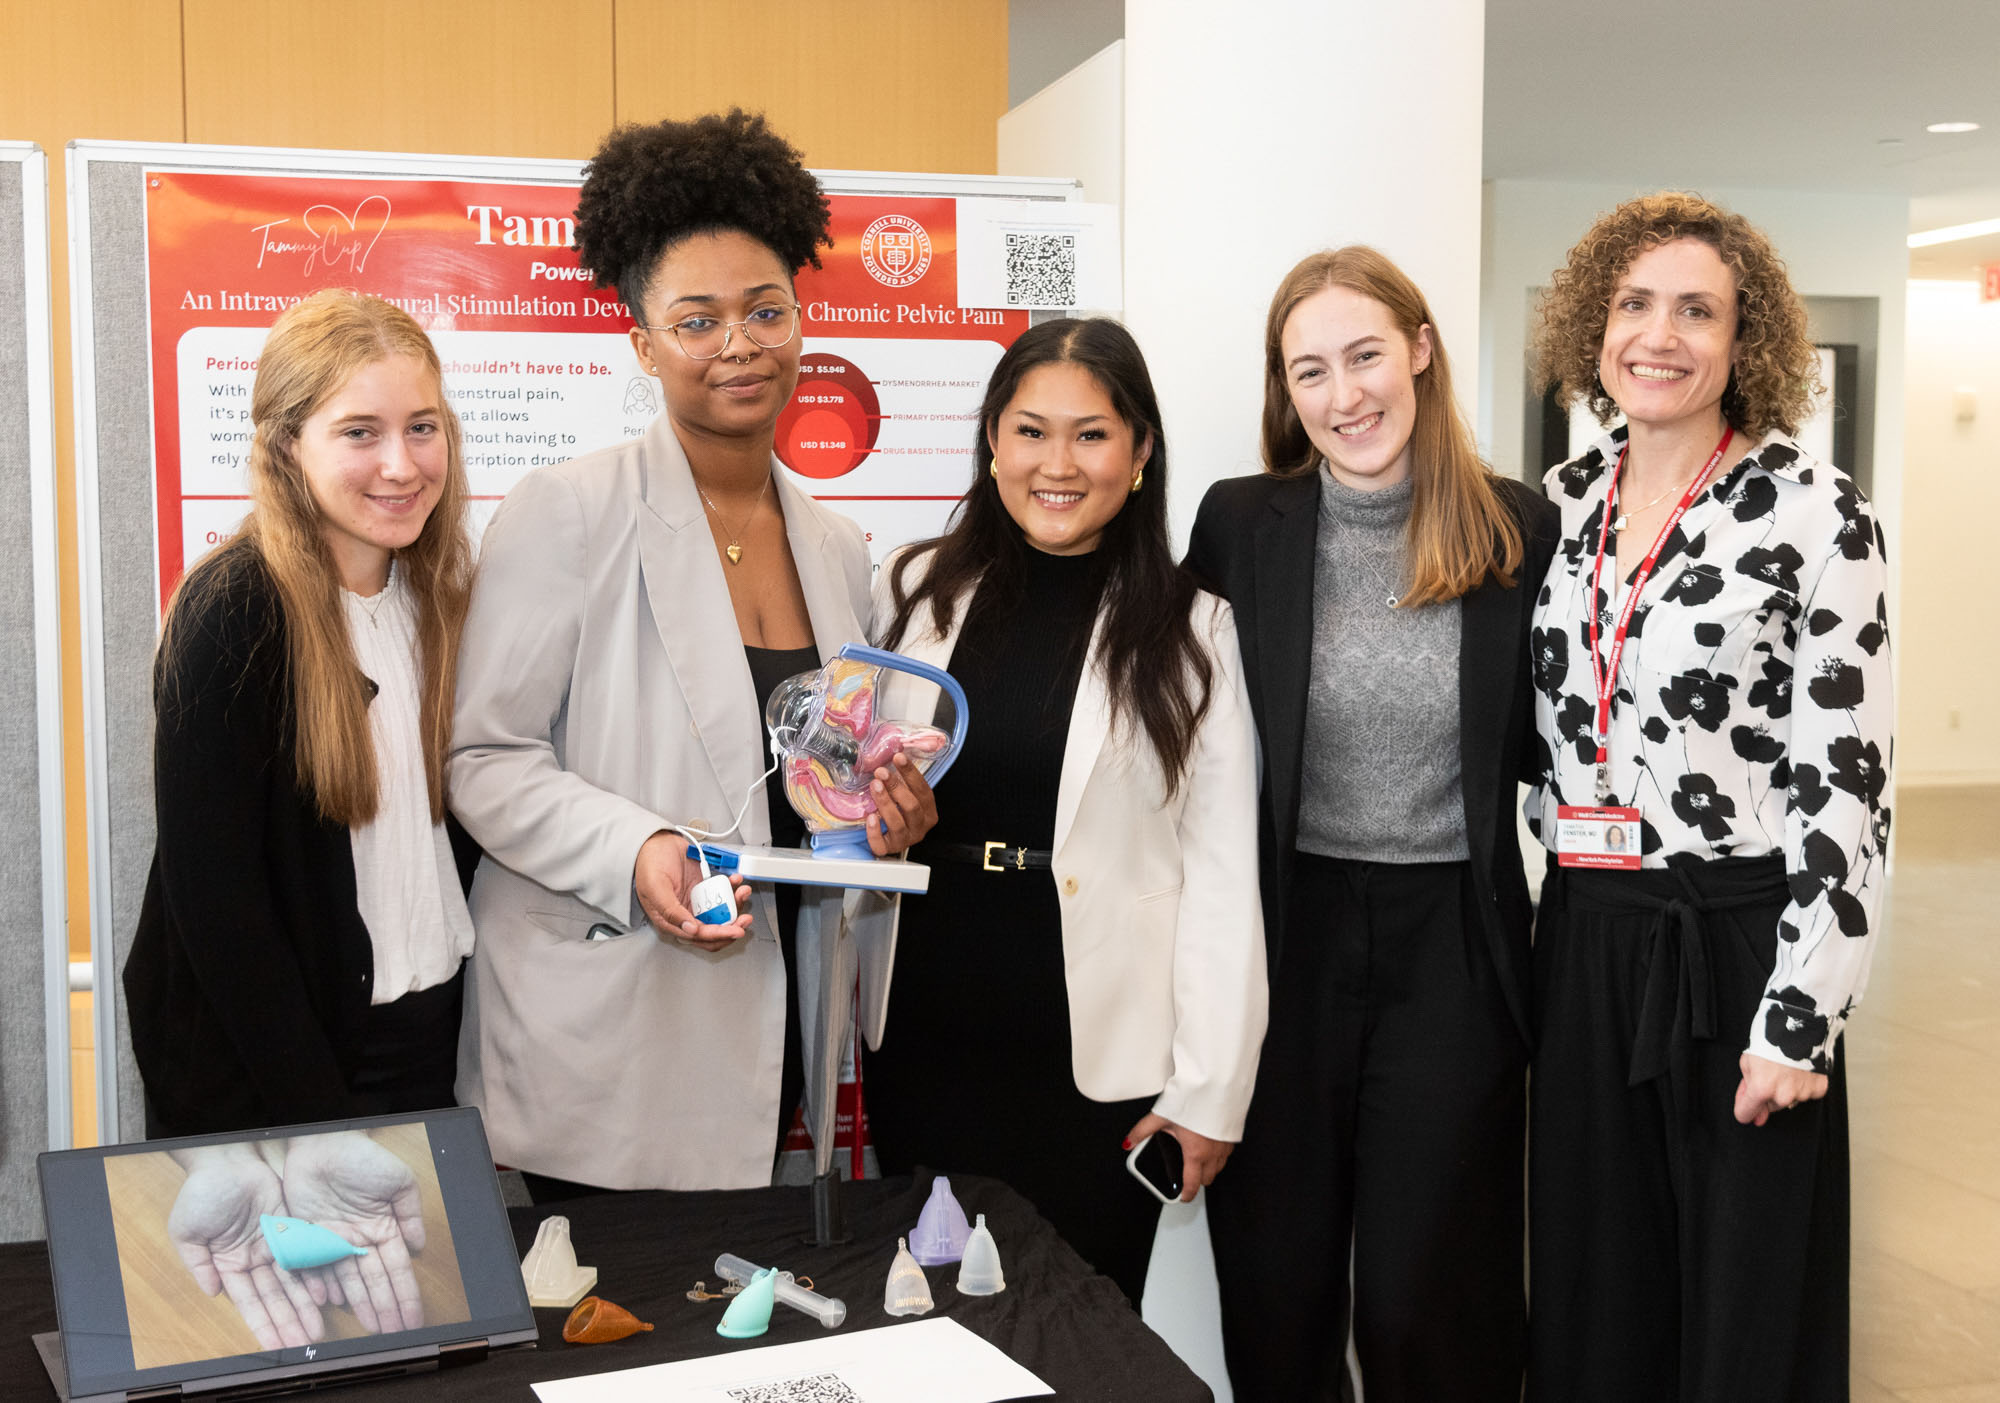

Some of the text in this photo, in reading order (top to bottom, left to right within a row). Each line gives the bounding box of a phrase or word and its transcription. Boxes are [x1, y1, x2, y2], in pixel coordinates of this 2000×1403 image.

[467, 205, 576, 247] Tam
[863, 217, 929, 253] CORNELL UNIVERSITY
[864, 255, 898, 285] FOUNDED
[180, 290, 213, 310] An
[447, 294, 576, 317] Stimulation
[807, 302, 891, 323] Chronic
[896, 304, 955, 325] Pelvic
[961, 308, 1005, 325] Pain
[526, 361, 563, 374] have
[569, 363, 584, 375] to
[589, 362, 612, 375] be.
[817, 365, 846, 374] $5.94B
[882, 380, 947, 388] DYSMENORRHEA
[208, 384, 247, 397] With
[526, 387, 565, 403] pain,
[210, 406, 235, 419] it's
[480, 409, 529, 421] allows
[505, 431, 557, 448] having
[561, 433, 576, 444] to
[800, 441, 818, 449] USD
[883, 447, 906, 455] DRUG
[908, 447, 934, 455] BASED
[211, 452, 240, 469] rely
